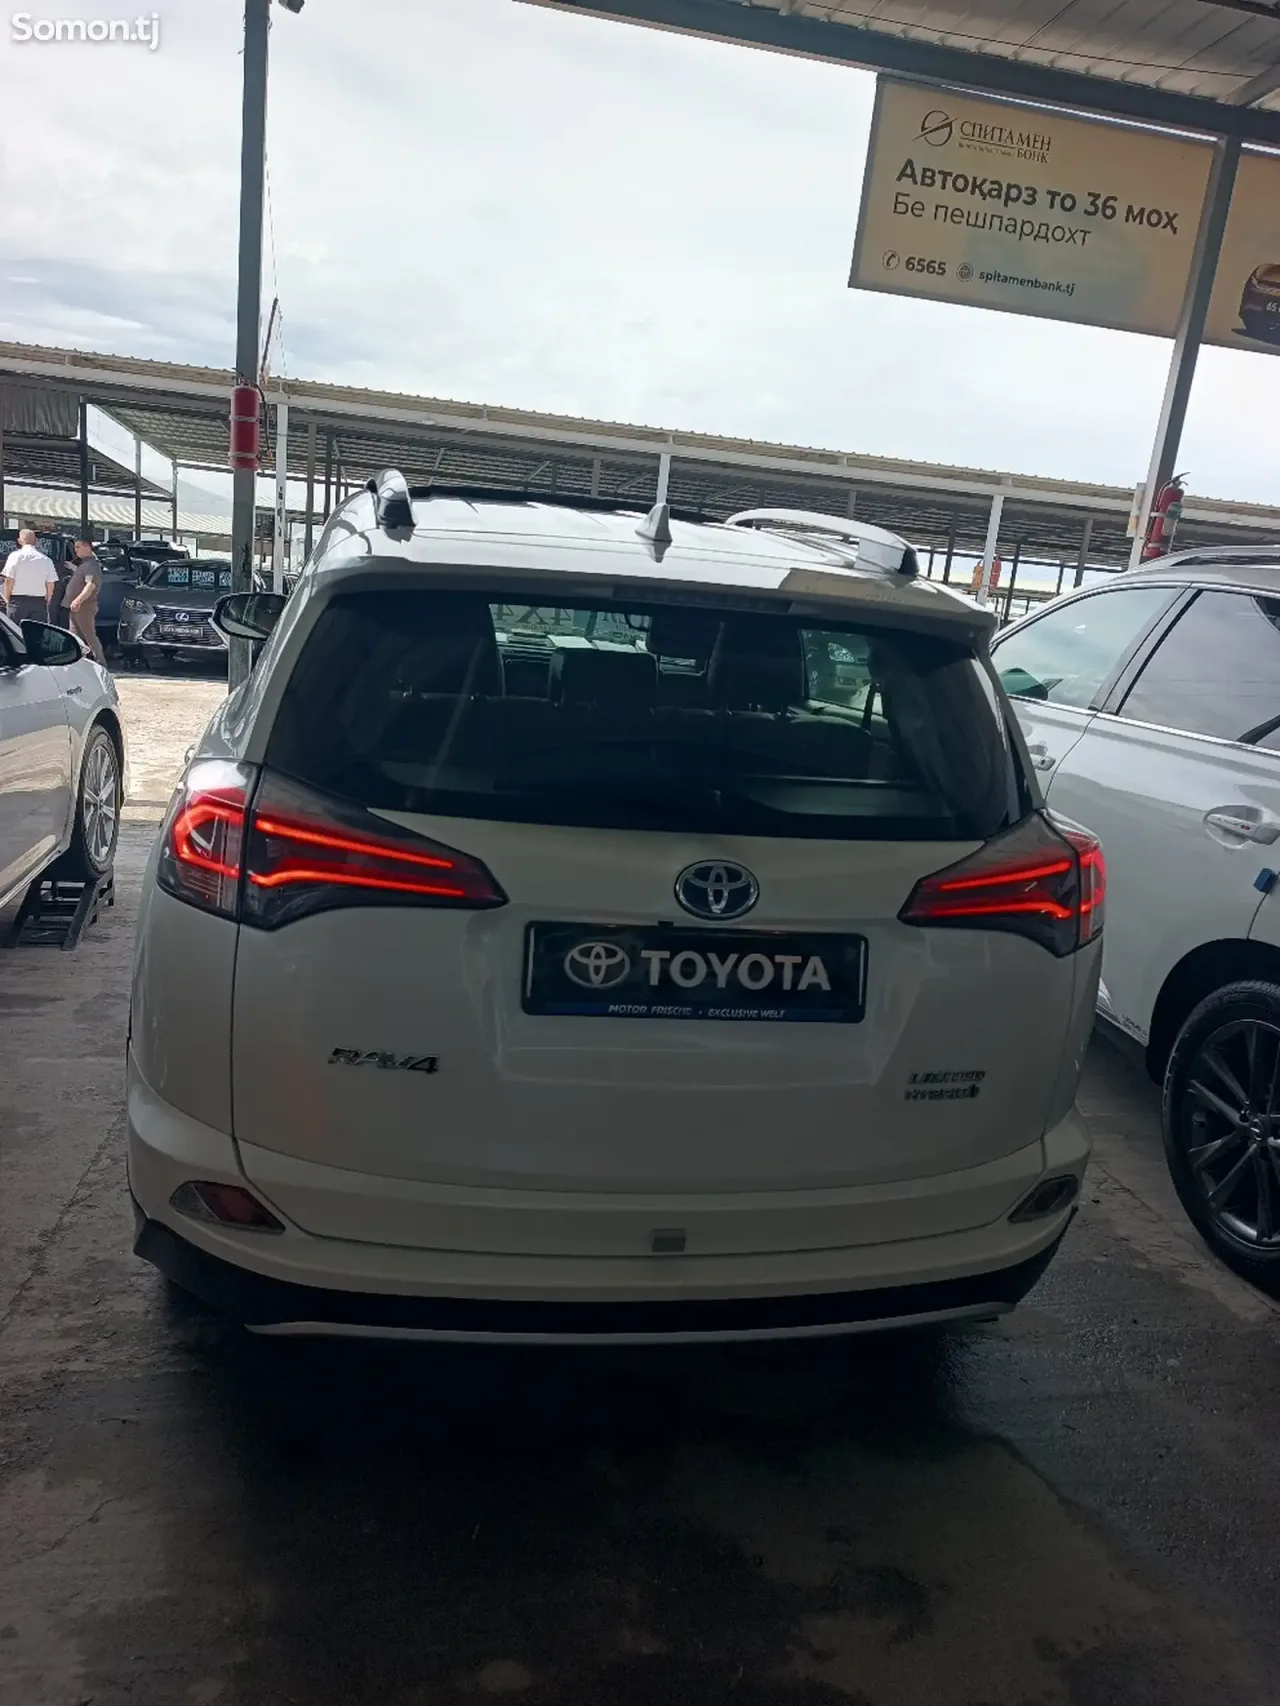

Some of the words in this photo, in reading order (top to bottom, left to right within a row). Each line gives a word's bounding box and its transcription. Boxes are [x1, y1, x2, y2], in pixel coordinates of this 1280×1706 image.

[960, 120, 1052, 151] СПИТАМЕН
[1016, 148, 1050, 163] БОНК
[896, 158, 1038, 208] Автоқарз
[1046, 189, 1078, 213] то
[1083, 191, 1118, 220] 36
[892, 191, 925, 218] Бе
[933, 204, 1092, 246] пешпардохт
[905, 256, 947, 276] 6565
[978, 269, 1076, 296] spitamenbank.tj
[640, 950, 832, 991] TOYOTA
[608, 1004, 648, 1014] MOTOR
[707, 1008, 758, 1018] EXCLUSIVE
[327, 1046, 438, 1074] RAV4
